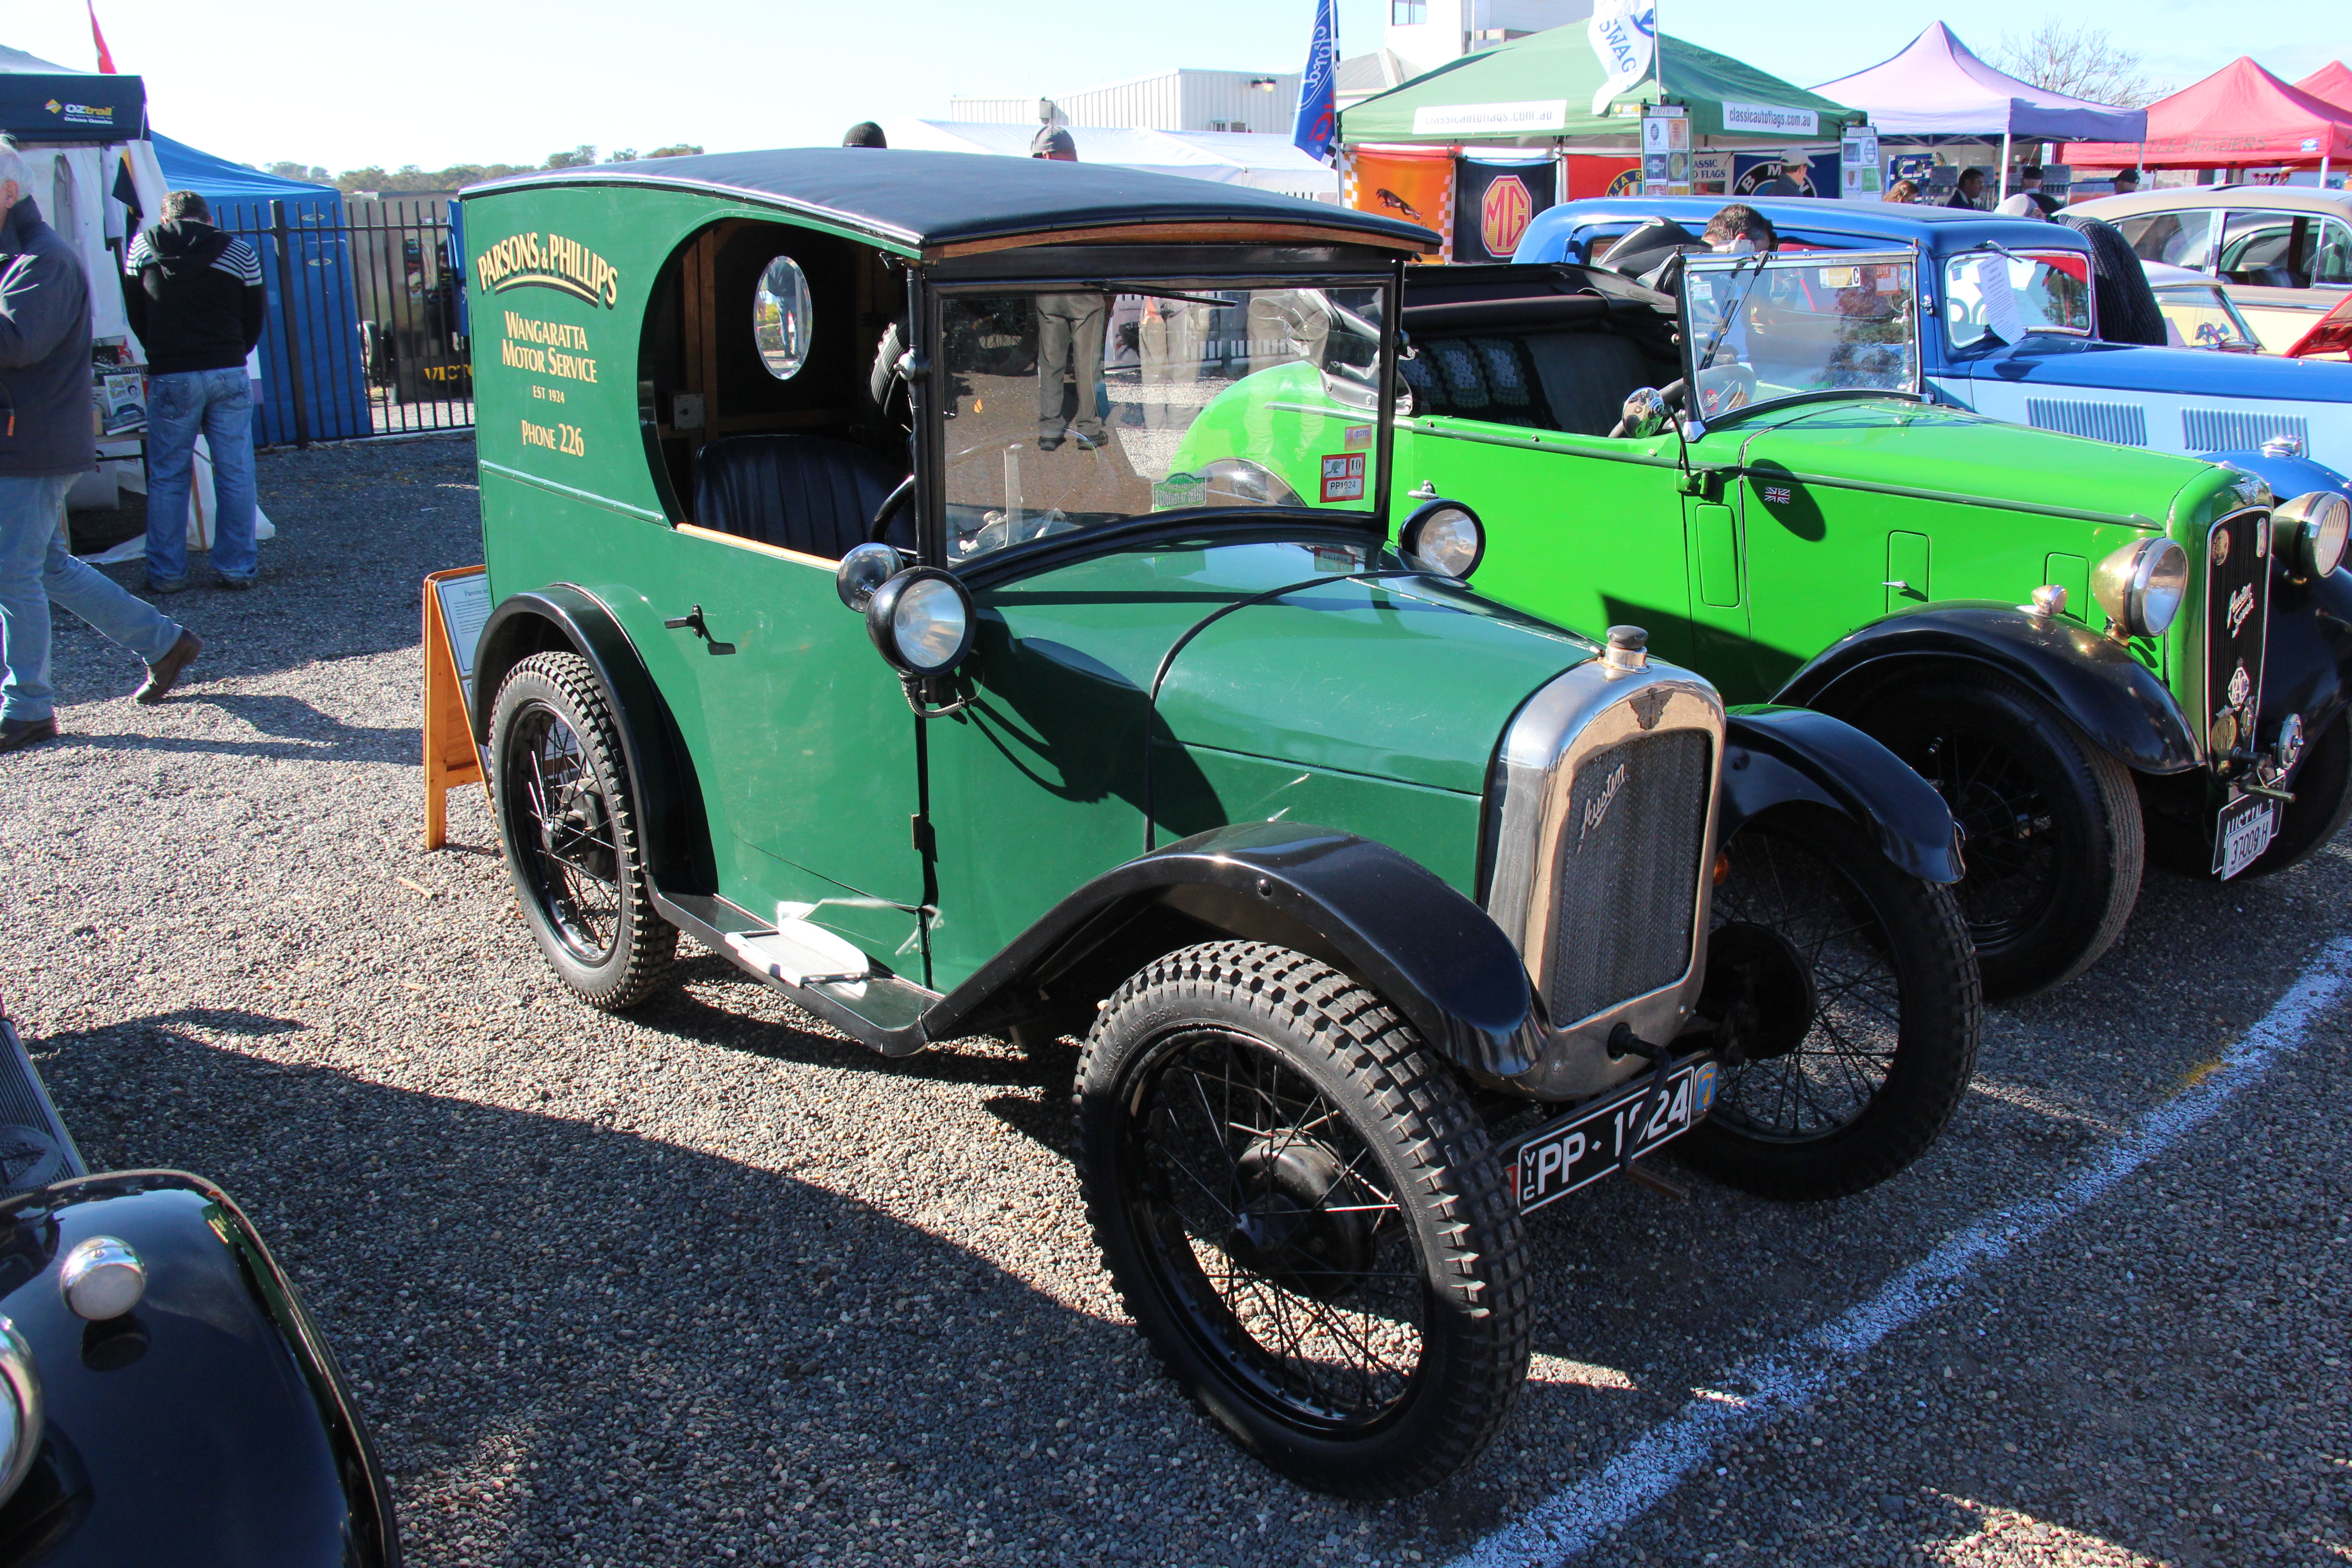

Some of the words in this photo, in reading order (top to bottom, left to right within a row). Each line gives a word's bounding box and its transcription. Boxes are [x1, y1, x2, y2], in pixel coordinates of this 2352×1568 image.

[65, 104, 113, 116] OZtrail
[1730, 107, 1811, 128] classicautoflags.com.au
[2182, 136, 2268, 152] HEADERS
[1701, 170, 1725, 179] FLAGS
[1485, 185, 1525, 247] MG
[477, 232, 540, 294] PARSONS
[541, 247, 548, 274] &
[548, 233, 618, 308] PHILLIPS
[1853, 268, 1859, 284] C
[1877, 267, 1889, 275] 2016
[505, 311, 588, 351] WANGARATTA
[502, 339, 546, 373] MOTOR
[549, 347, 598, 383] SERVICE
[533, 385, 545, 399] EST
[549, 389, 565, 404] 1924
[521, 419, 556, 450] PHONE
[559, 423, 584, 457] 226
[1350, 459, 1361, 471] 10
[1330, 480, 1356, 490] PP1924
[2231, 671, 2246, 702] RAC
[1578, 764, 1626, 853] Austin
[1702, 1071, 1715, 1106] 7
[1523, 1151, 1536, 1201] VIC
